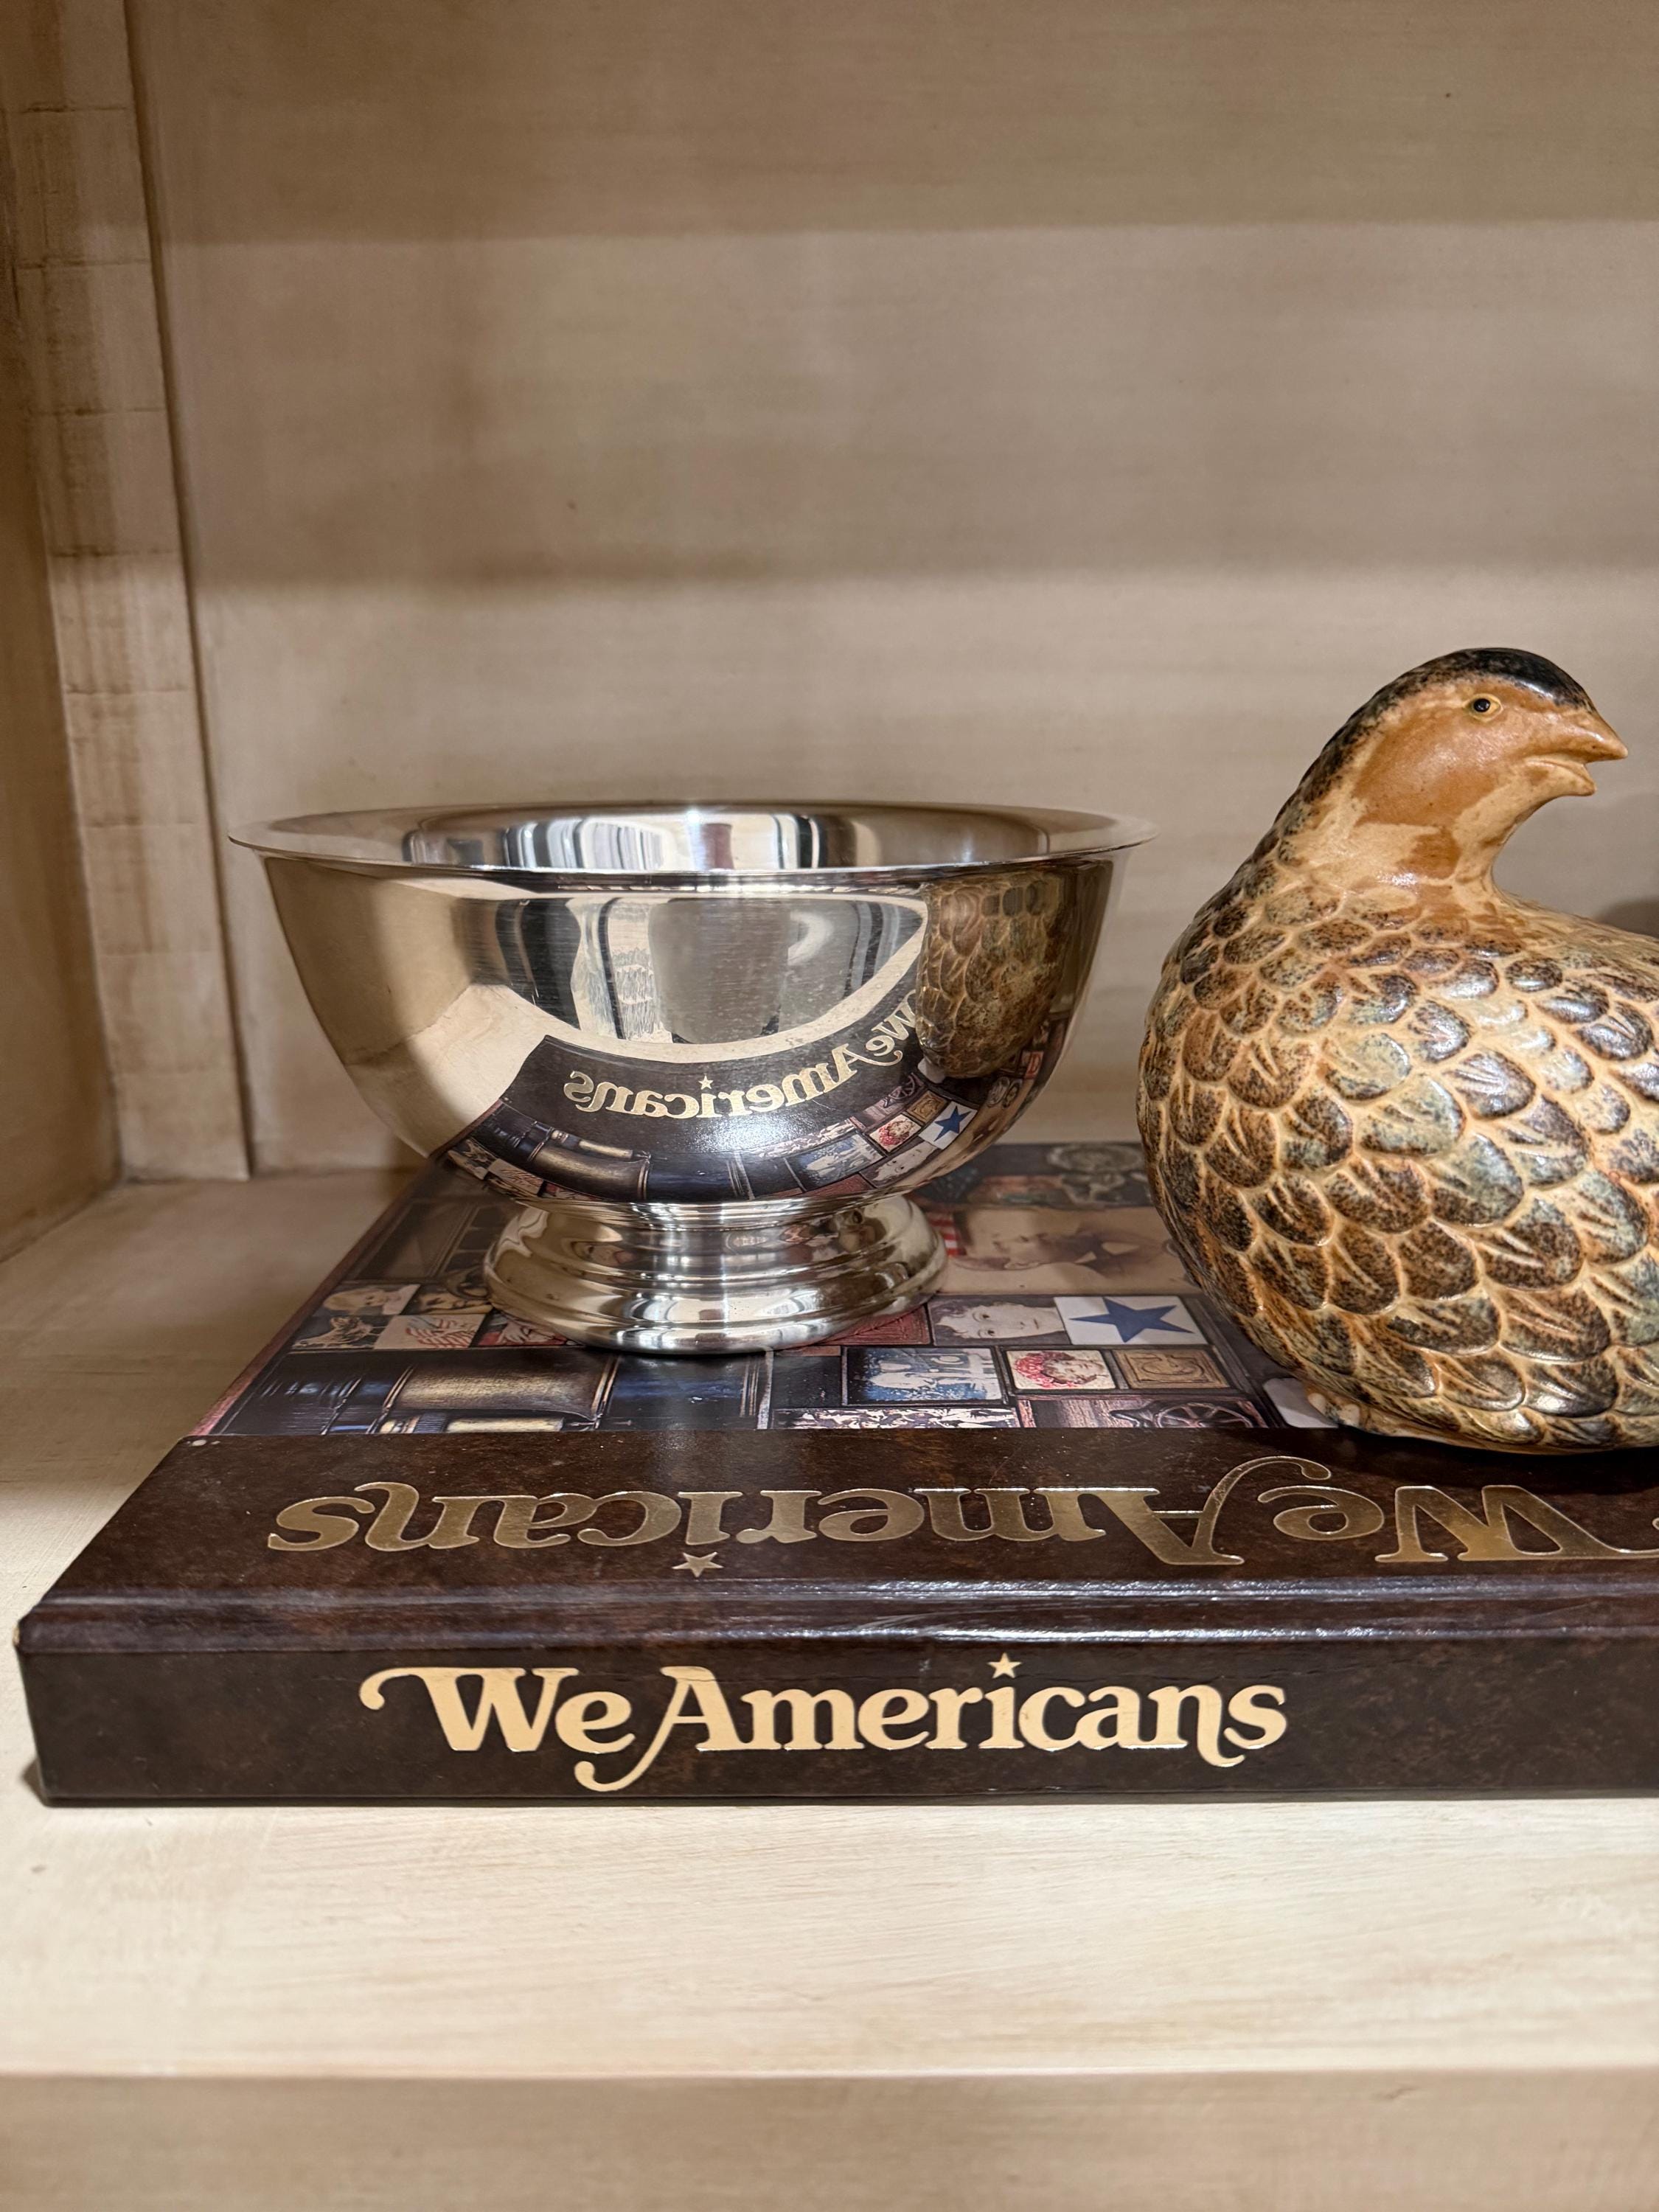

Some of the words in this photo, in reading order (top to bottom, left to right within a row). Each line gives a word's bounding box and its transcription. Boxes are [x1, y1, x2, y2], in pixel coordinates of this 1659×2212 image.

[267, 1455, 1332, 1577] Americans
[1256, 1485, 1659, 1563] We
[360, 1666, 636, 1753] We
[574, 1652, 1288, 1792] Americans
